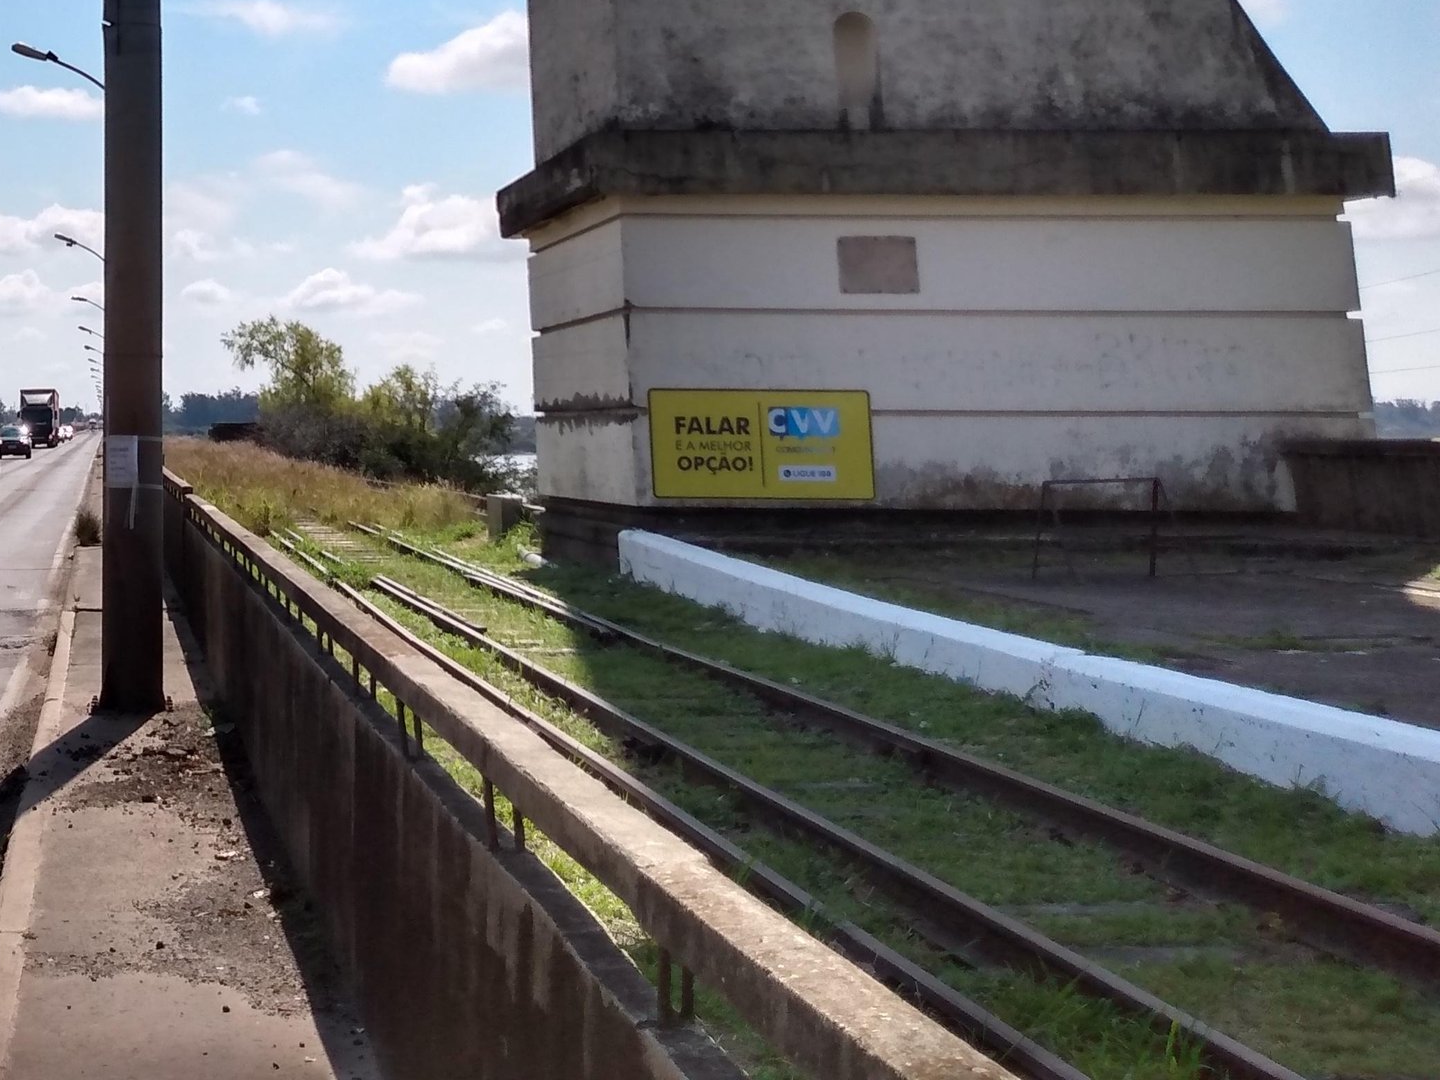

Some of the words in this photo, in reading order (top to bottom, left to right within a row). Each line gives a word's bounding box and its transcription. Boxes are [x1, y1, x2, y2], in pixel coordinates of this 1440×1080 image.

[674, 416, 750, 435] FALAR
[768, 408, 835, 433] CVV
[686, 440, 695, 451] A
[699, 440, 752, 452] MELHOR
[677, 451, 754, 476] OPÇÃO!
